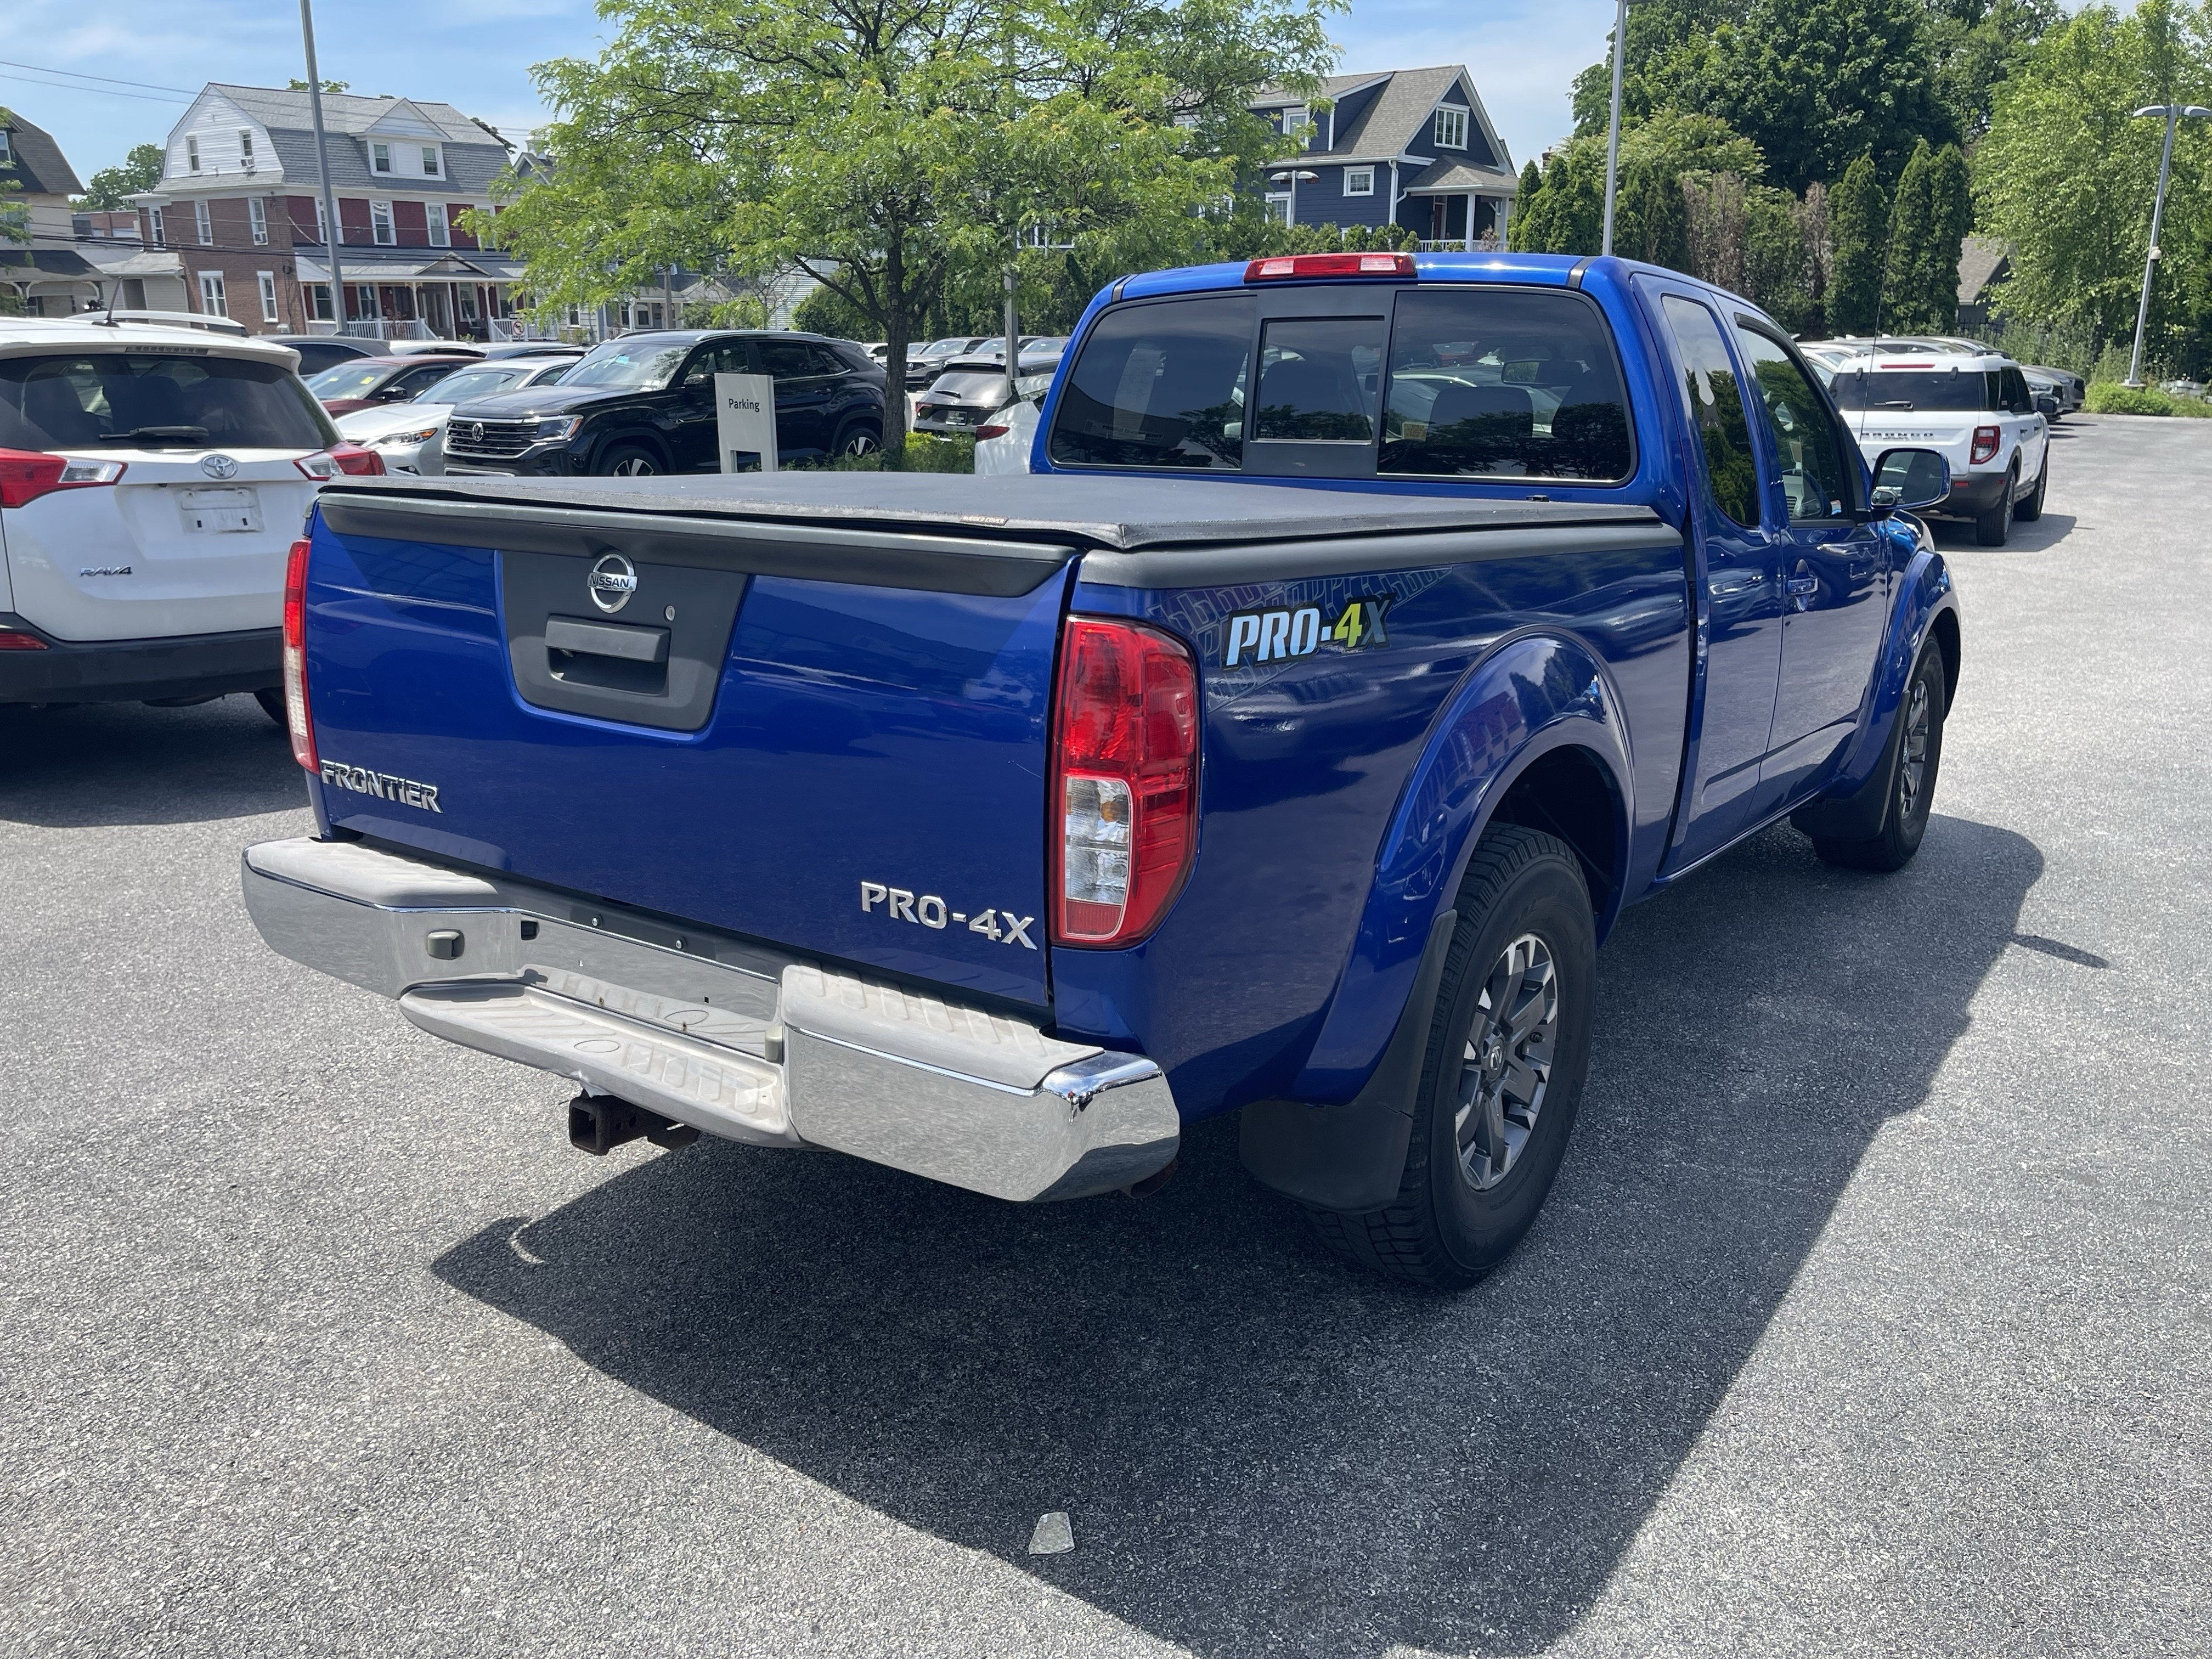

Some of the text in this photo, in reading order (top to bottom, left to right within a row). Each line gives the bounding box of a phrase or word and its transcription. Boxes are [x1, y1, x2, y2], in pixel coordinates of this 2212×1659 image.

[729, 398, 760, 413] Parking
[80, 566, 132, 577] RAV4
[590, 575, 630, 588] NISSAN
[1225, 599, 1390, 667] PRO-4X
[321, 759, 444, 814] FRONTIER
[861, 881, 1039, 950] PRO-4X
